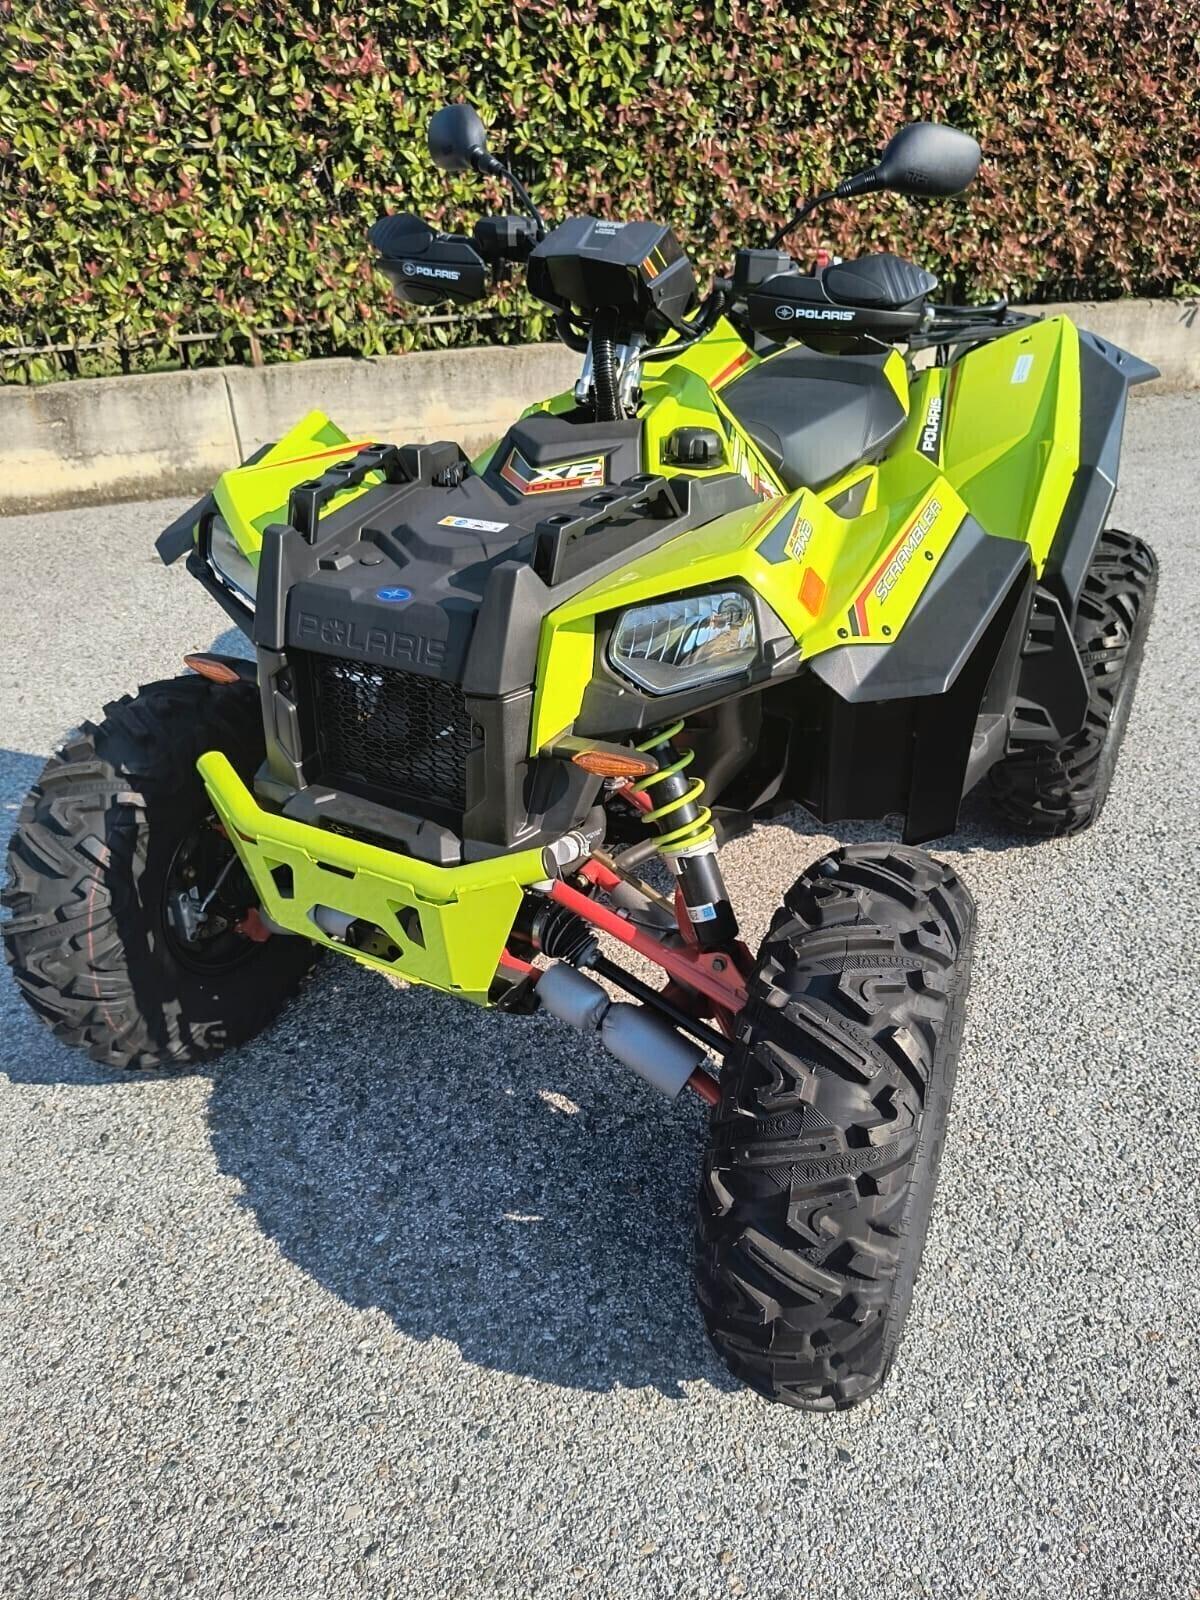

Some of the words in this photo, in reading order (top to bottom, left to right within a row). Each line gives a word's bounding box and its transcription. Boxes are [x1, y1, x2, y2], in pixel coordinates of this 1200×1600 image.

[416, 266, 461, 280] POLARIS
[795, 308, 856, 321] POLARIS
[921, 398, 942, 452] POLARIS
[529, 462, 602, 484] XP
[874, 498, 943, 605] SCRAMBLER
[297, 611, 447, 668] POLARIS
